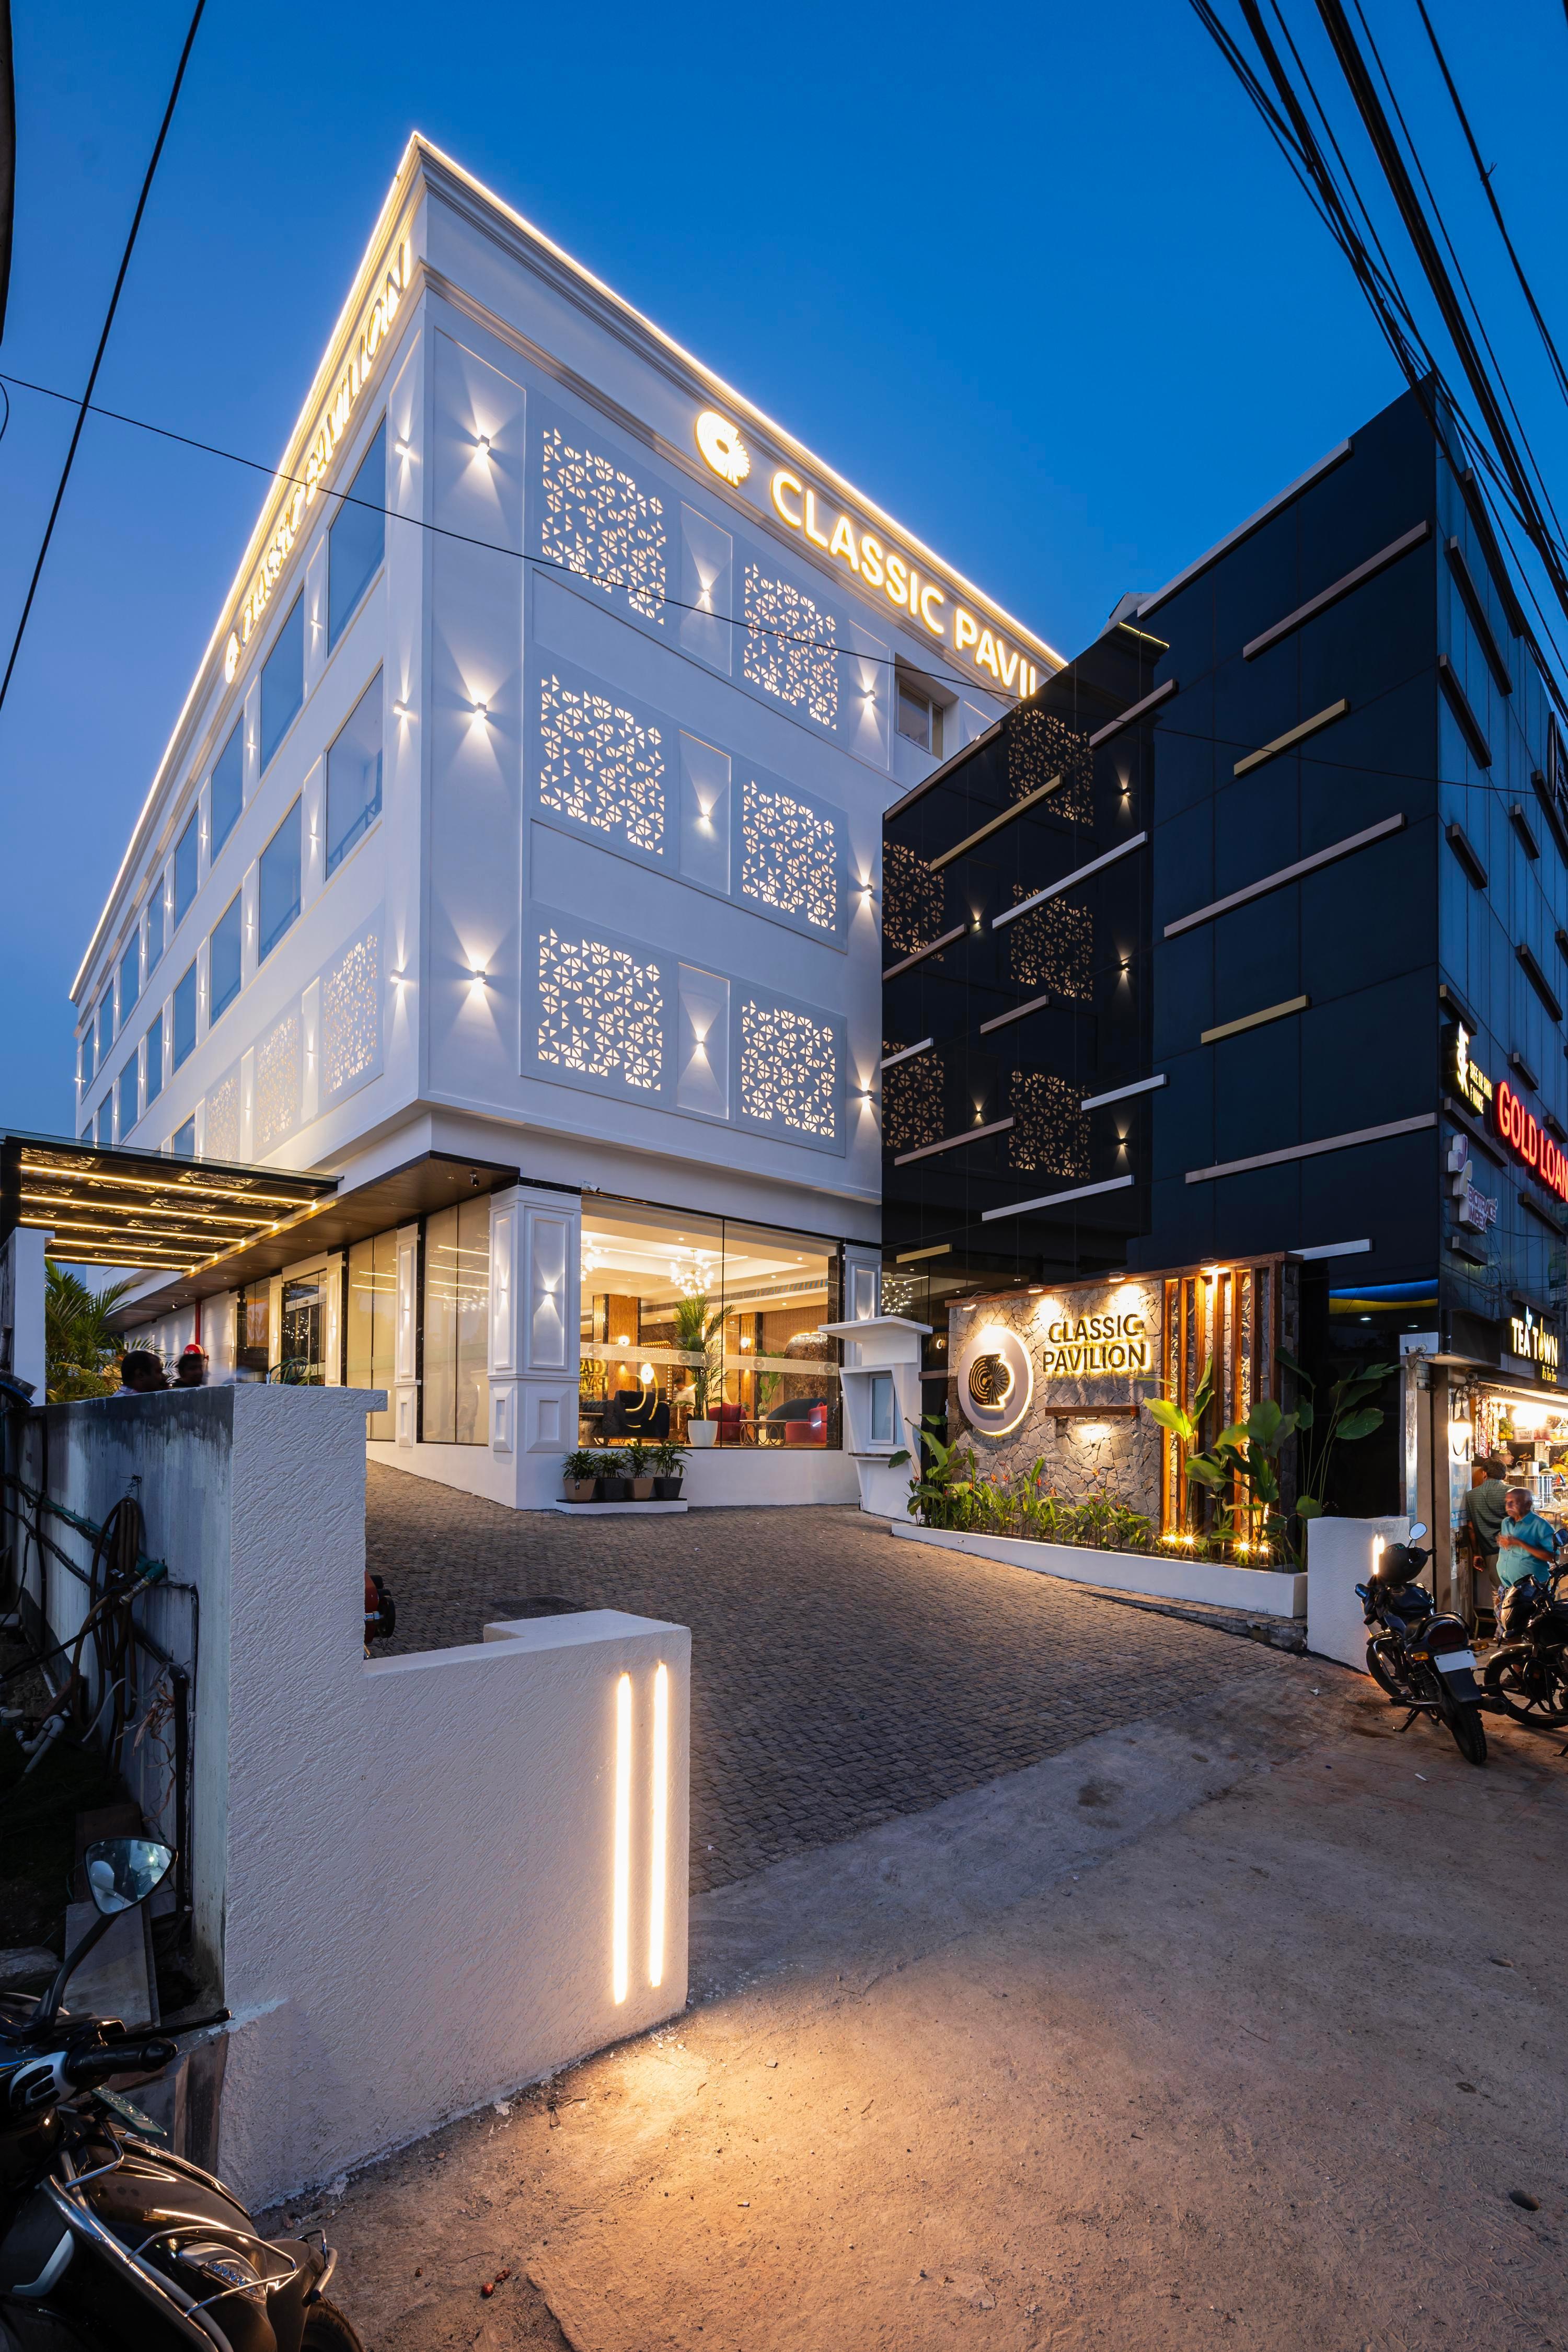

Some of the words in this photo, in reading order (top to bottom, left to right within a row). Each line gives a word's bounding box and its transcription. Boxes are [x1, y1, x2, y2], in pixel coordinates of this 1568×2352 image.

[771, 471, 945, 635] CLASSIC
[1499, 1081, 1538, 1167] GOLD
[1048, 1313, 1138, 1343] CLASSIC
[1512, 1317, 1531, 1358] TEA
[1532, 1317, 1558, 1367] TOWN
[1043, 1343, 1146, 1372] PAVILION
